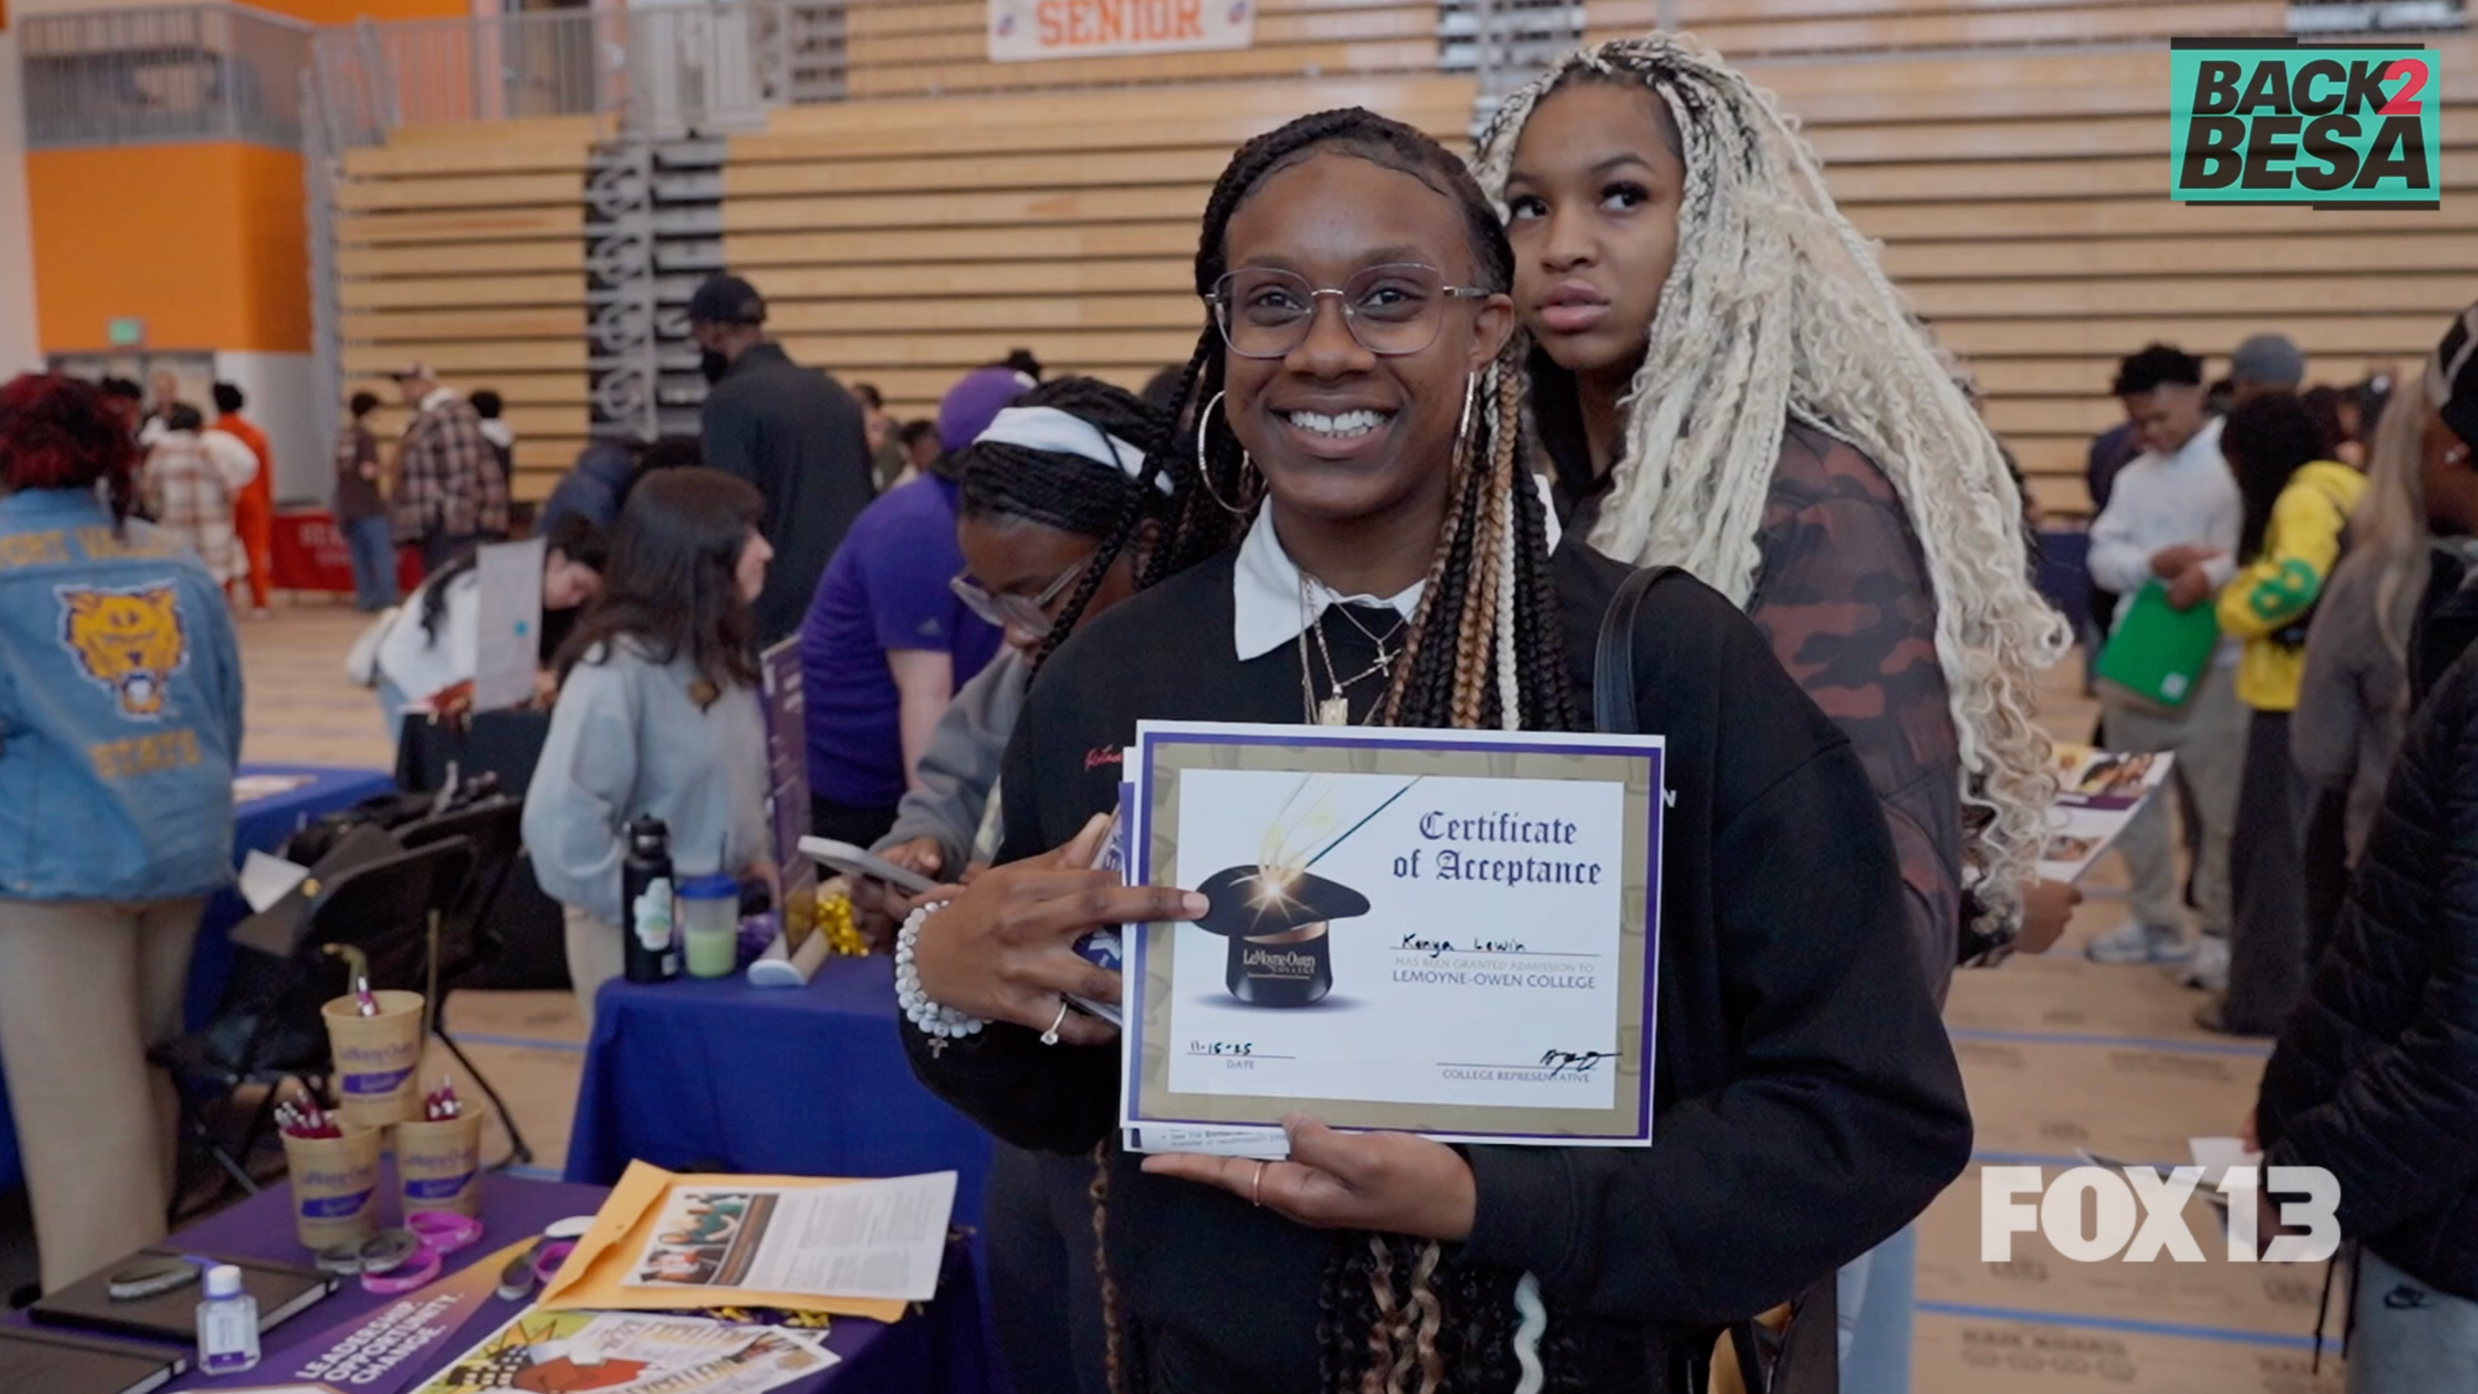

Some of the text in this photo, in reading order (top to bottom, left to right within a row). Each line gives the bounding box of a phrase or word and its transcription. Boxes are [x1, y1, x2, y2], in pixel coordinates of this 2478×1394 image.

[1035, 0, 1205, 48] SENIOR
[1419, 810, 1577, 845] Certificate
[1393, 848, 1602, 887] of Acceptance
[1392, 970, 1596, 990] LEMOYNE-OWEN COLLEGE
[1395, 957, 1594, 974] HAS BEEN GRANTED ADMISSION TO
[1226, 1060, 1255, 1070] DATE
[1442, 1069, 1591, 1083] COLLEGE REPRESENTATIVE
[295, 1301, 423, 1379] LEADERSHIP.
[324, 1293, 465, 1382] OPPORTUNITY.
[350, 1325, 447, 1384] CHANGE.
